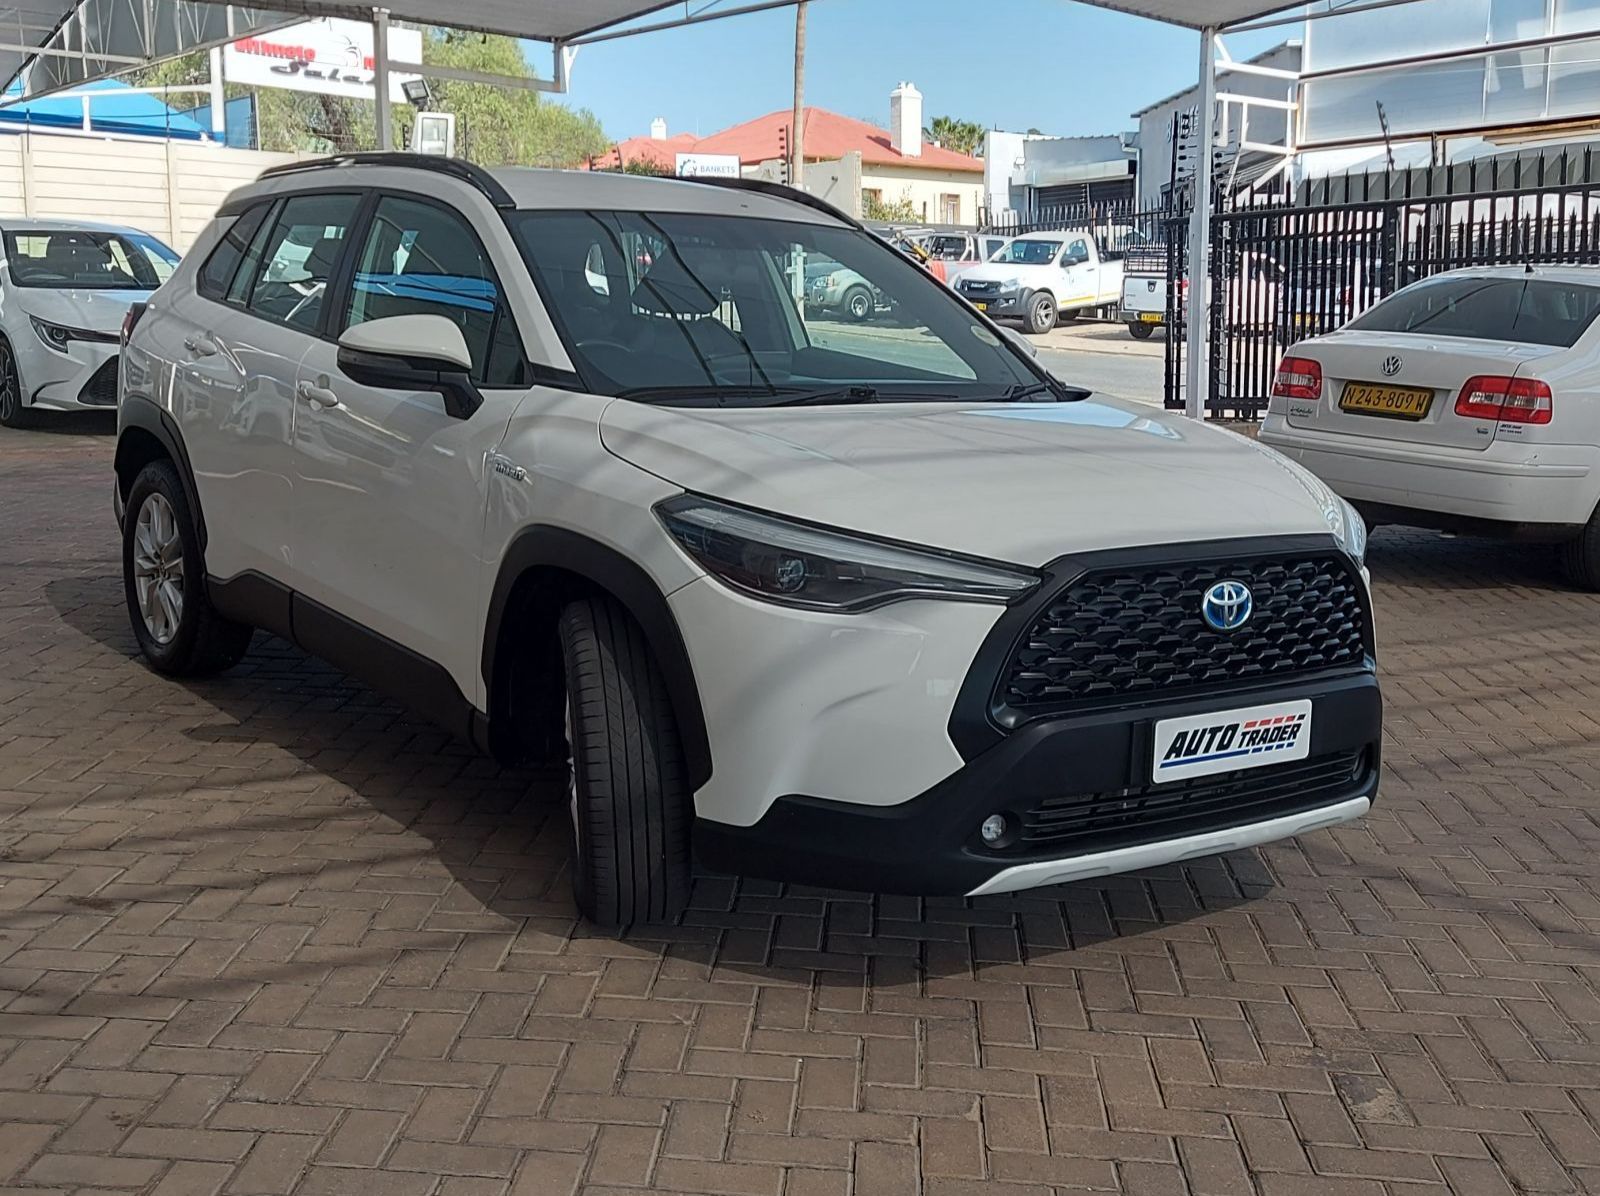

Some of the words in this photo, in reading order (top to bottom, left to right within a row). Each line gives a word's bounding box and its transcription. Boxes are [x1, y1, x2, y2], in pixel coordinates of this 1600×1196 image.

[700, 165, 736, 174] BANKETS
[1355, 389, 1414, 410] 243-809
[1163, 723, 1240, 760] AUTO
[1238, 722, 1303, 749] TRADER
